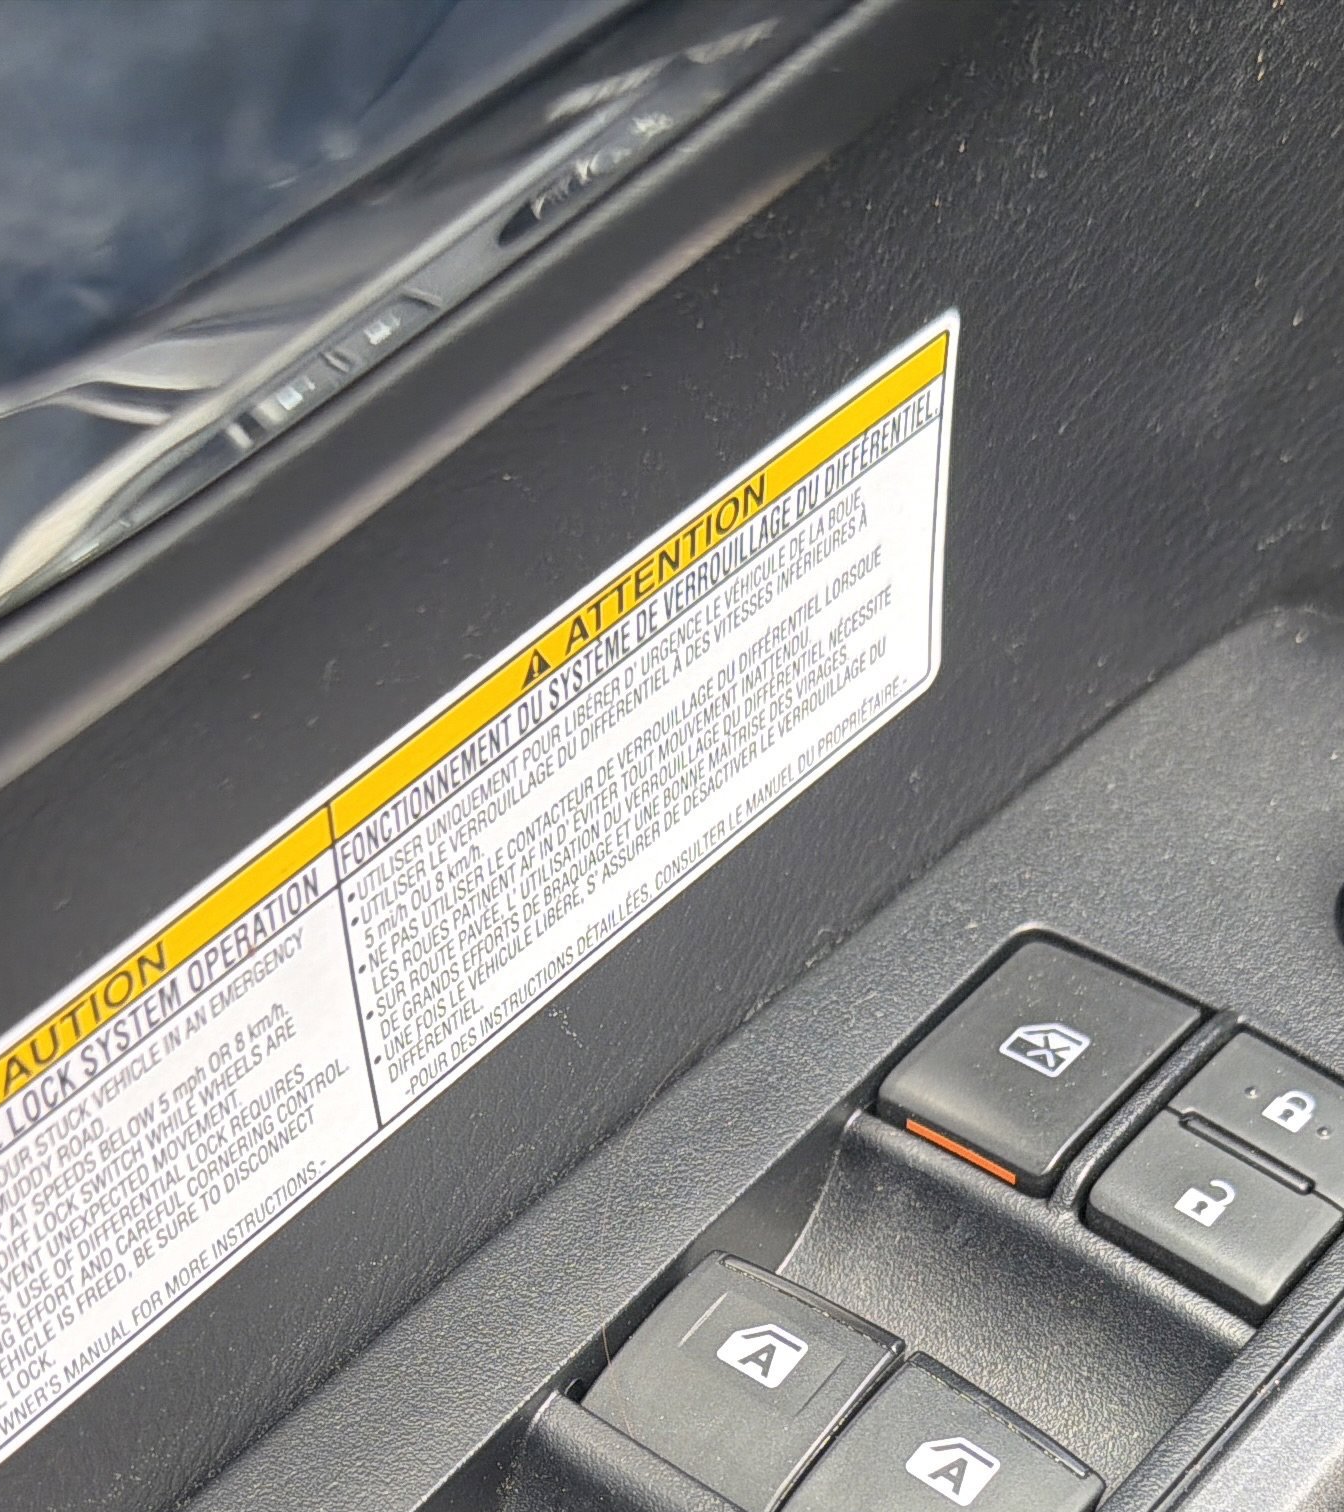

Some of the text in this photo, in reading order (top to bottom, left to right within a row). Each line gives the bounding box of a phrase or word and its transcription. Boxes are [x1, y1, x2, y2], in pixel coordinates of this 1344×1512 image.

[340, 384, 937, 875] FONCTIONNEMENT DU SYSTÈME DE VERROUILLAGE DU DIFFÉRENTIEL.
[564, 473, 764, 655] ATTENTION
[357, 833, 422, 901] UTILISER
[426, 756, 519, 847] UNIQUEMENT
[523, 723, 560, 771] POUR
[565, 676, 619, 737] LIBÉRER
[706, 596, 719, 626] LE
[725, 546, 784, 611] VÉHICULE
[790, 530, 804, 561] DE
[810, 515, 823, 546] LA
[361, 504, 866, 925] UTILISER LE VERROUILLAGE DU DIFFÉRENTIEL À DES VITESSES INFÉRIEURES À
[369, 545, 880, 972] NE PAS UTILISER LE CONTACTEUR DE VERROUILLAGE DU DIFFÉRENTIEL LORSQUE
[364, 838, 483, 950] 5 mi/h OU 8 km/h.
[381, 1010, 399, 1040] DE
[402, 960, 458, 1022] GRANDS
[463, 911, 518, 973] EFFORTS
[523, 894, 539, 923] DE
[544, 834, 612, 906] BRAQUAGE
[616, 819, 630, 847] ET
[635, 795, 658, 832] UNE
[664, 758, 703, 808] BONNE
[709, 709, 764, 772] MAÎTRISE
[770, 688, 791, 722] DES
[385, 1024, 412, 1061] UNE
[416, 996, 446, 1036] FOIS
[450, 980, 465, 1008] LE
[468, 925, 531, 993] VÉHICULE
[536, 883, 583, 937] LIBÉRÉ,
[664, 803, 678, 832] DE
[684, 740, 755, 816] DÉSACTIVER
[761, 726, 773, 753] LE
[779, 652, 864, 739] VERROUILLAGE
[870, 636, 884, 665] DU
[5, 1061, 77, 1136] LOCK
[79, 977, 182, 1078] SYSTEM
[186, 867, 320, 994] OPERATION
[7, 1205, 29, 1234] AT
[31, 1151, 96, 1215] SPEEDS
[98, 1102, 157, 1161] BELOW
[158, 1092, 169, 1114] 5
[171, 1063, 205, 1103] mph
[208, 1042, 231, 1074] OR
[234, 1031, 245, 1053] 8
[248, 997, 287, 1042] km/h.
[34, 1098, 90, 1156] STUCK
[92, 1043, 160, 1111] VEHICLE
[163, 1026, 181, 1055] IN
[183, 1006, 207, 1039] AN
[209, 927, 305, 1018] EMERGENCY
[389, 991, 482, 1084] DIFFÉRENTIEL.
[17, 1270, 51, 1309] USE
[53, 1250, 75, 1280] OF
[77, 1161, 184, 1260] DIFFERENTIAL
[187, 1126, 227, 1172] LOCK
[230, 1063, 304, 1136] REQUIRES
[17, 1275, 77, 1337] EFFORT
[78, 1246, 113, 1287] AND
[115, 1187, 184, 1256] CAREFUL
[186, 1113, 274, 1198] CORNERING
[277, 1052, 348, 1125] CONTROL.
[33, 1193, 78, 1241] LOCK
[80, 1140, 143, 1204] SWITCH
[145, 1097, 196, 1151] WHILE
[199, 1043, 262, 1108] WHEELS
[264, 1017, 295, 1055] ARE
[46, 1162, 149, 1259] UNEXPECTED
[152, 1088, 240, 1173] MOVEMENT.
[56, 1114, 107, 1167] ROAD.
[57, 1304, 74, 1331] IS
[76, 1257, 131, 1315] FREED,
[133, 1238, 154, 1268] BE
[156, 1202, 198, 1250] SURE
[200, 1183, 221, 1213] TO
[223, 1104, 315, 1194] DISCONNECT
[7, 1347, 55, 1398] LOCK.
[64, 1317, 129, 1383] MANUAL
[132, 1289, 162, 1326] FOR
[165, 1250, 209, 1298] MORE
[739, 1343, 777, 1379] A
[929, 1457, 970, 1496] A
